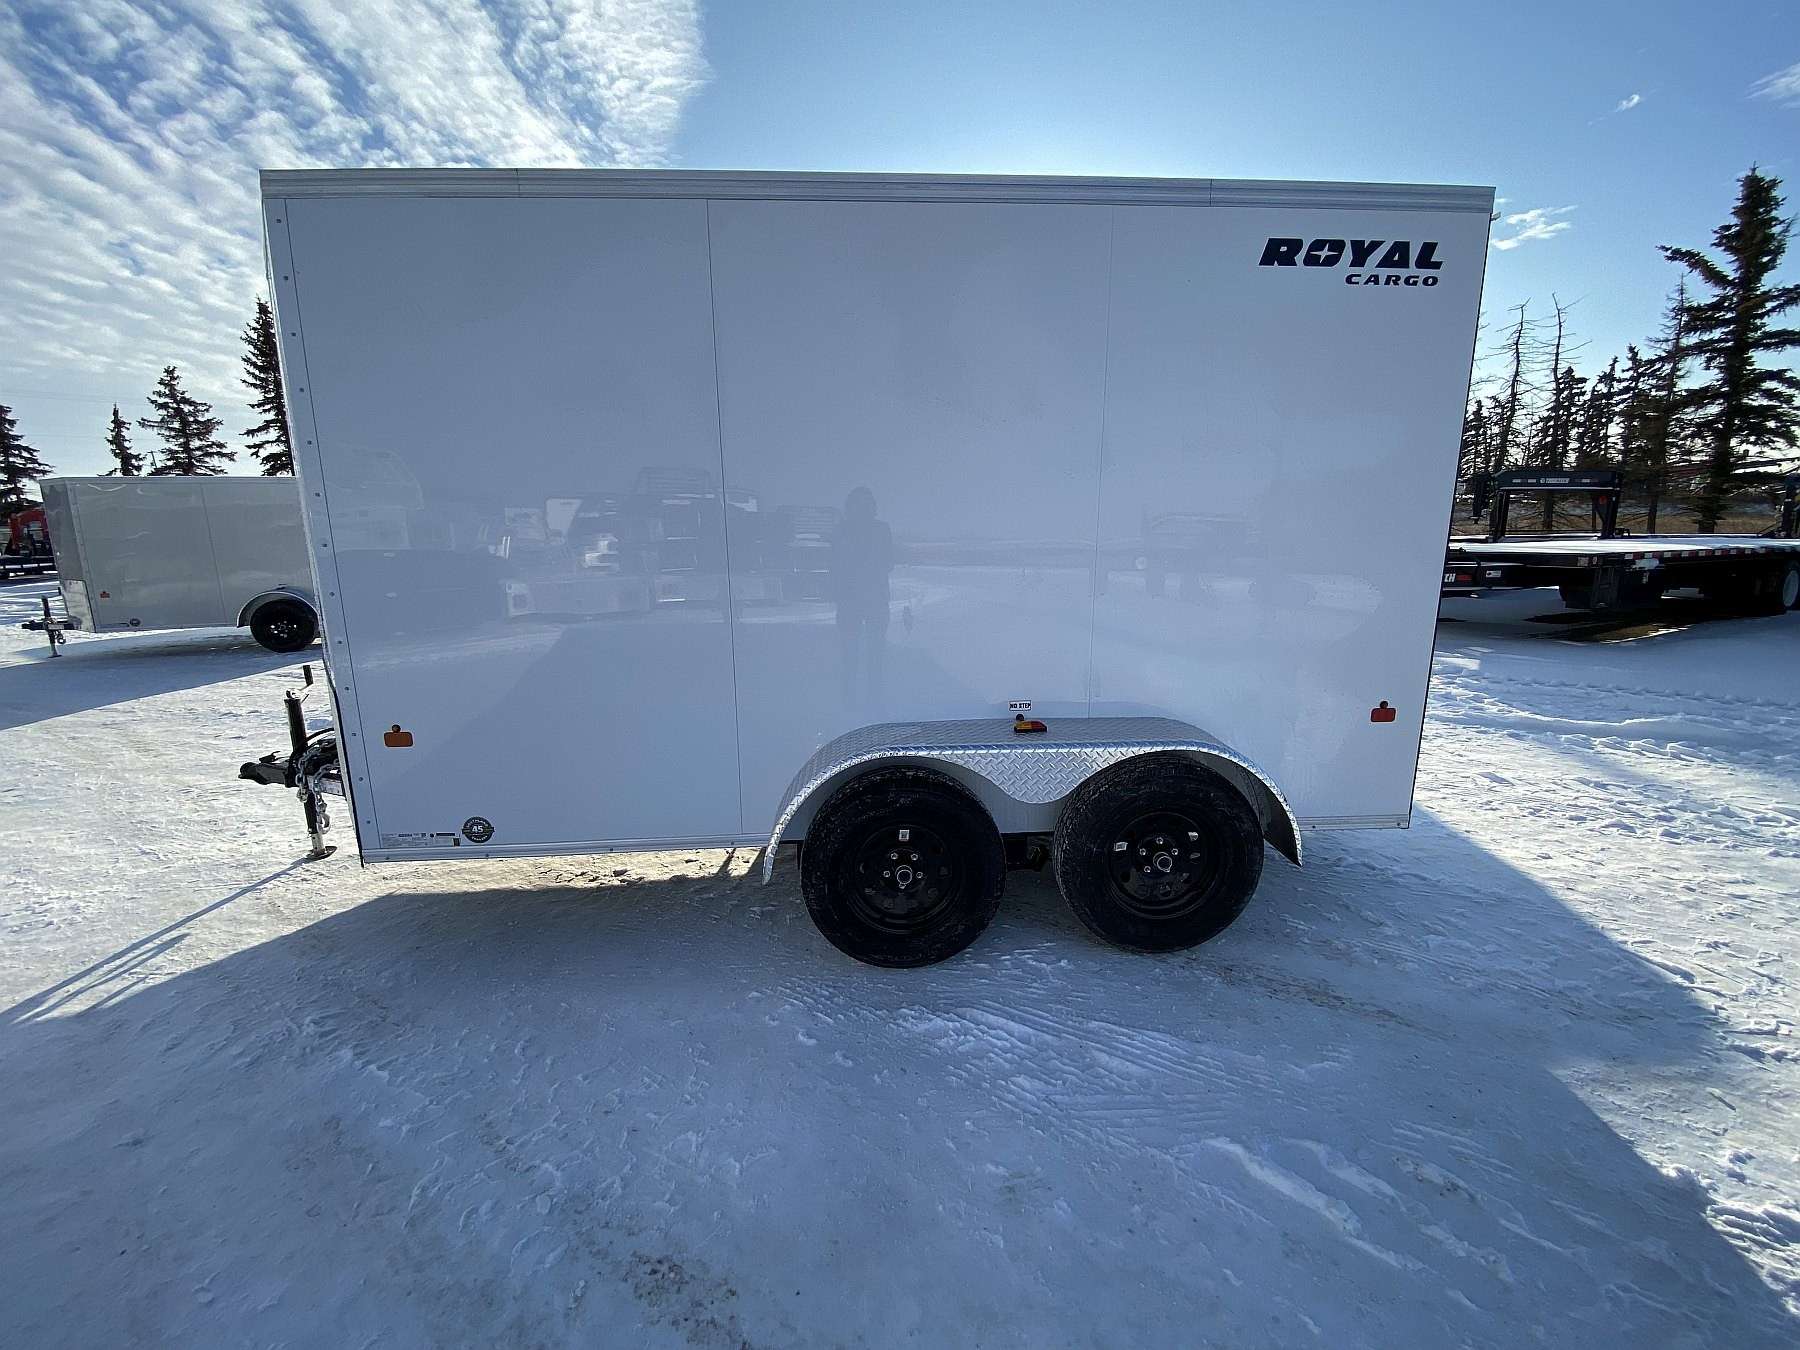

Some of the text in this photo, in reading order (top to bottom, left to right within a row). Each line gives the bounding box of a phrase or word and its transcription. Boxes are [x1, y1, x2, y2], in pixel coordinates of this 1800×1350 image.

[1258, 237, 1443, 270] ROYAL
[1345, 273, 1439, 287] CARGO
[471, 825, 484, 833] 45
